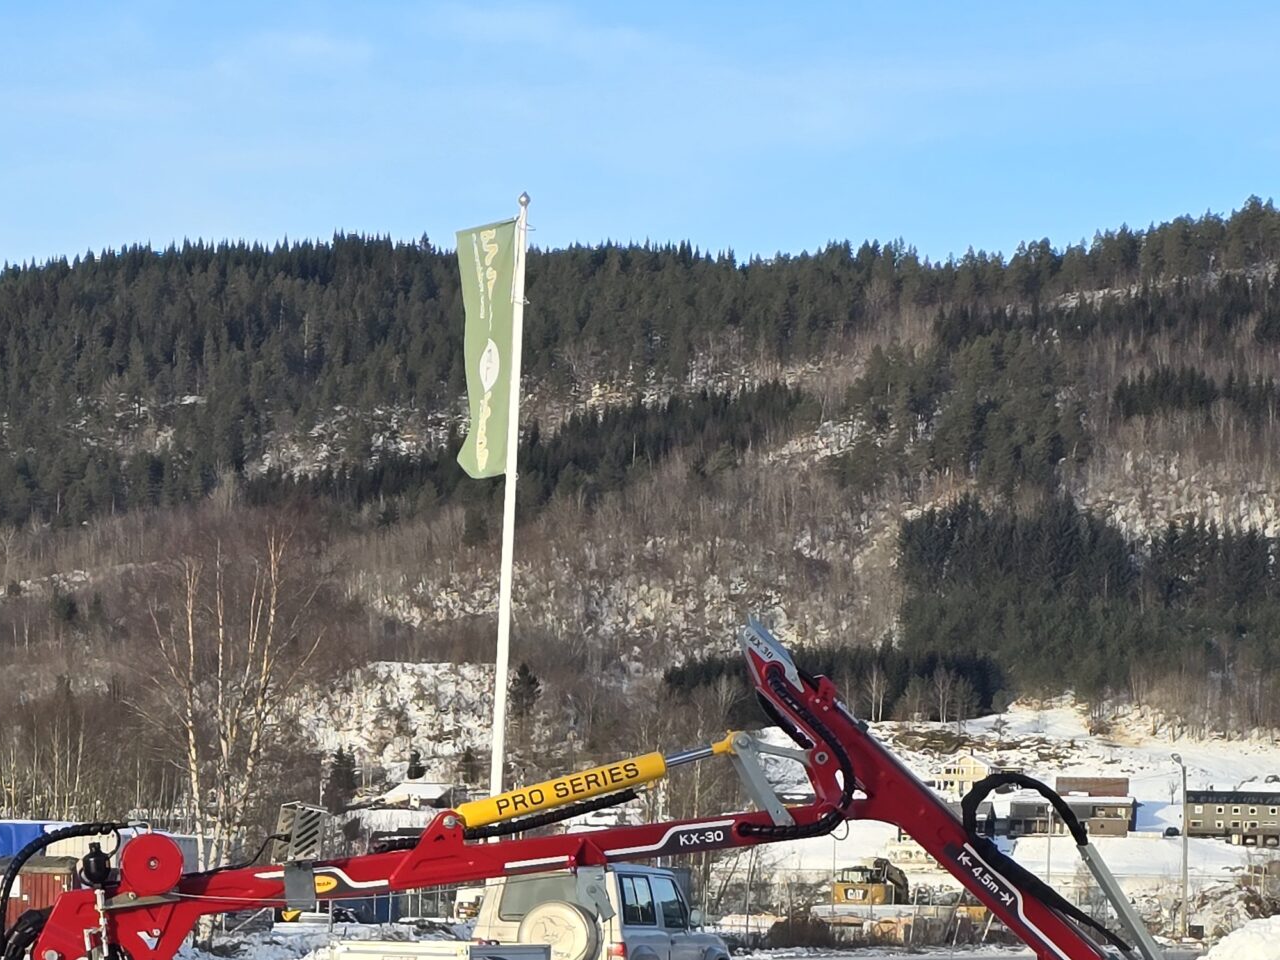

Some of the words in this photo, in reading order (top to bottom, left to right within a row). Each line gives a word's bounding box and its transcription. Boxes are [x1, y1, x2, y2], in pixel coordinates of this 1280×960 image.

[496, 789, 545, 815] PRO
[553, 762, 640, 798] SERIES
[679, 830, 724, 847] KX-30
[971, 866, 999, 893] 4,5m
